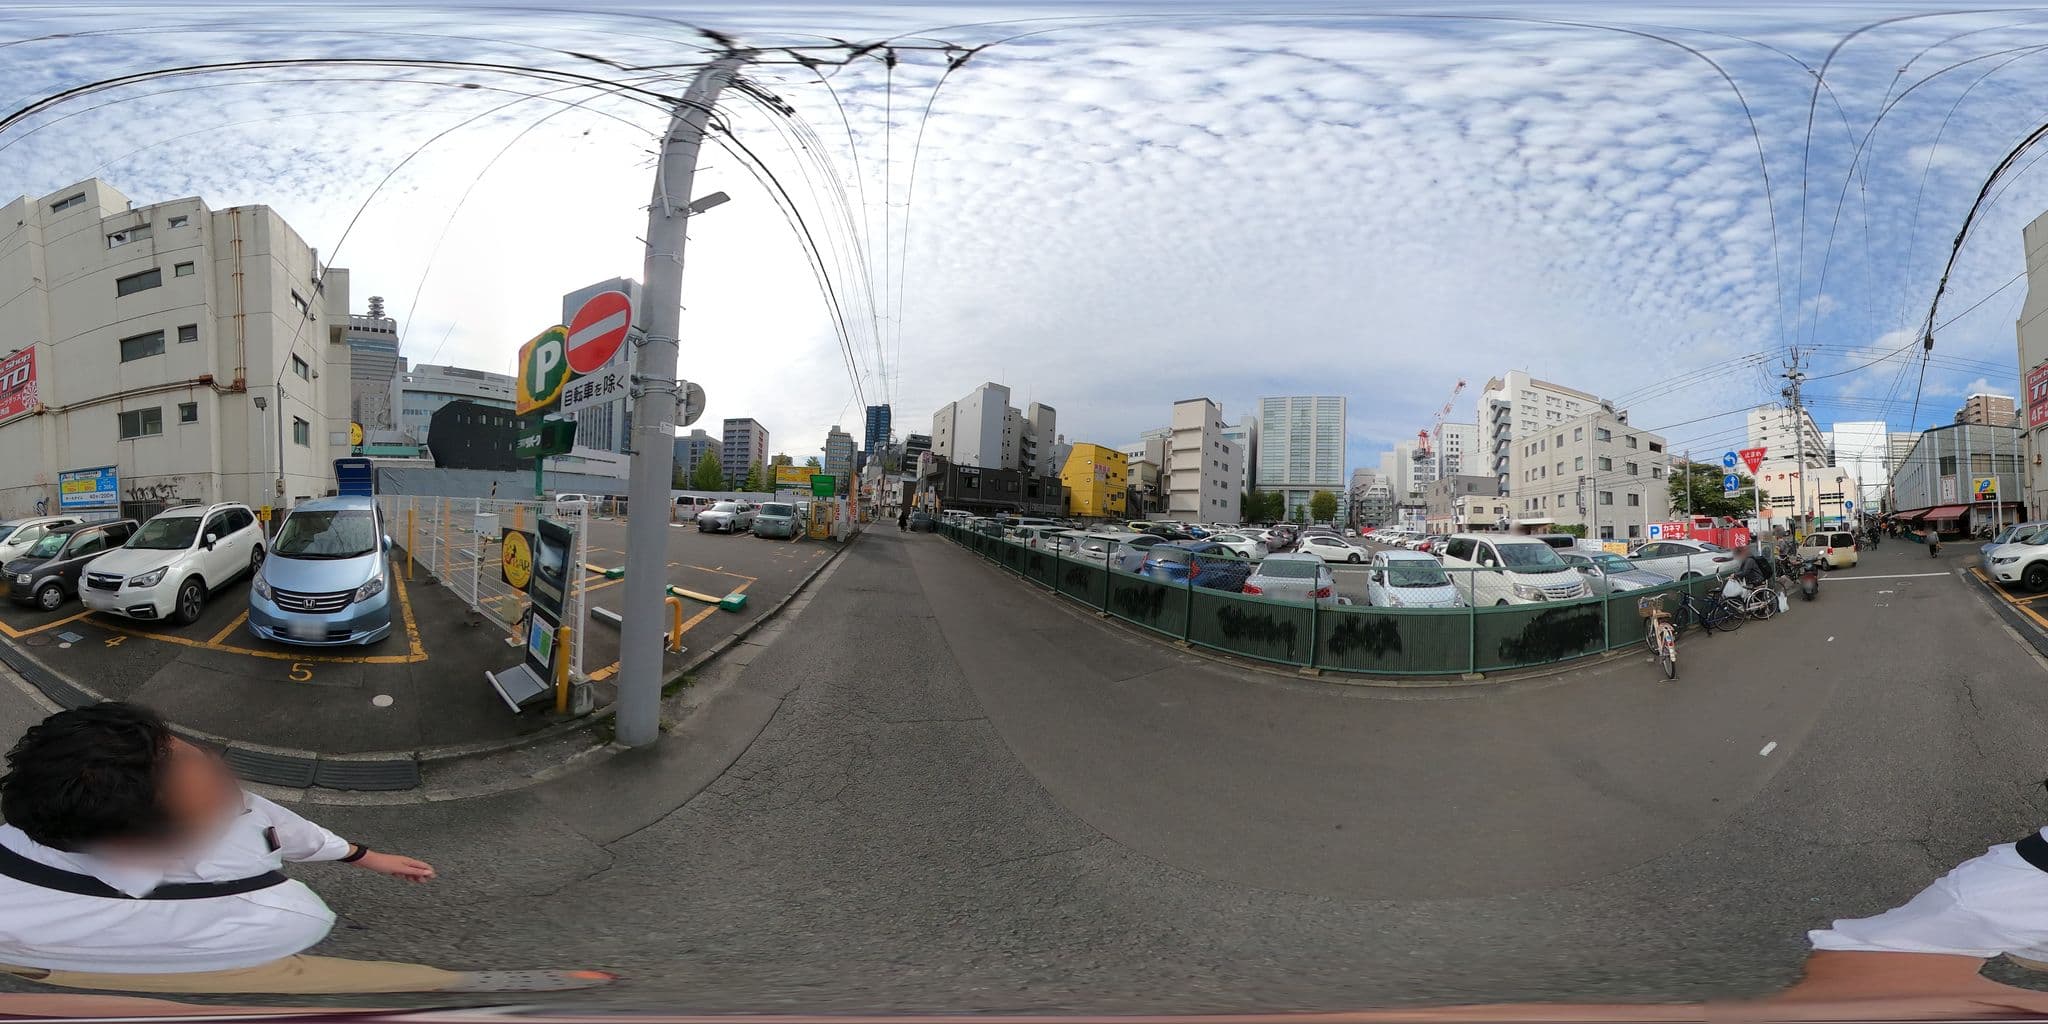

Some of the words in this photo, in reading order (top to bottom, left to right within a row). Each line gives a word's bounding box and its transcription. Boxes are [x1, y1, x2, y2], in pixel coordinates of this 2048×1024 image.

[535, 340, 562, 394] P
[564, 373, 624, 407] 自転車を除く
[1650, 526, 1660, 539] P
[1663, 524, 1681, 532] カネマ
[104, 635, 128, 648] 4
[289, 662, 314, 682] 5
